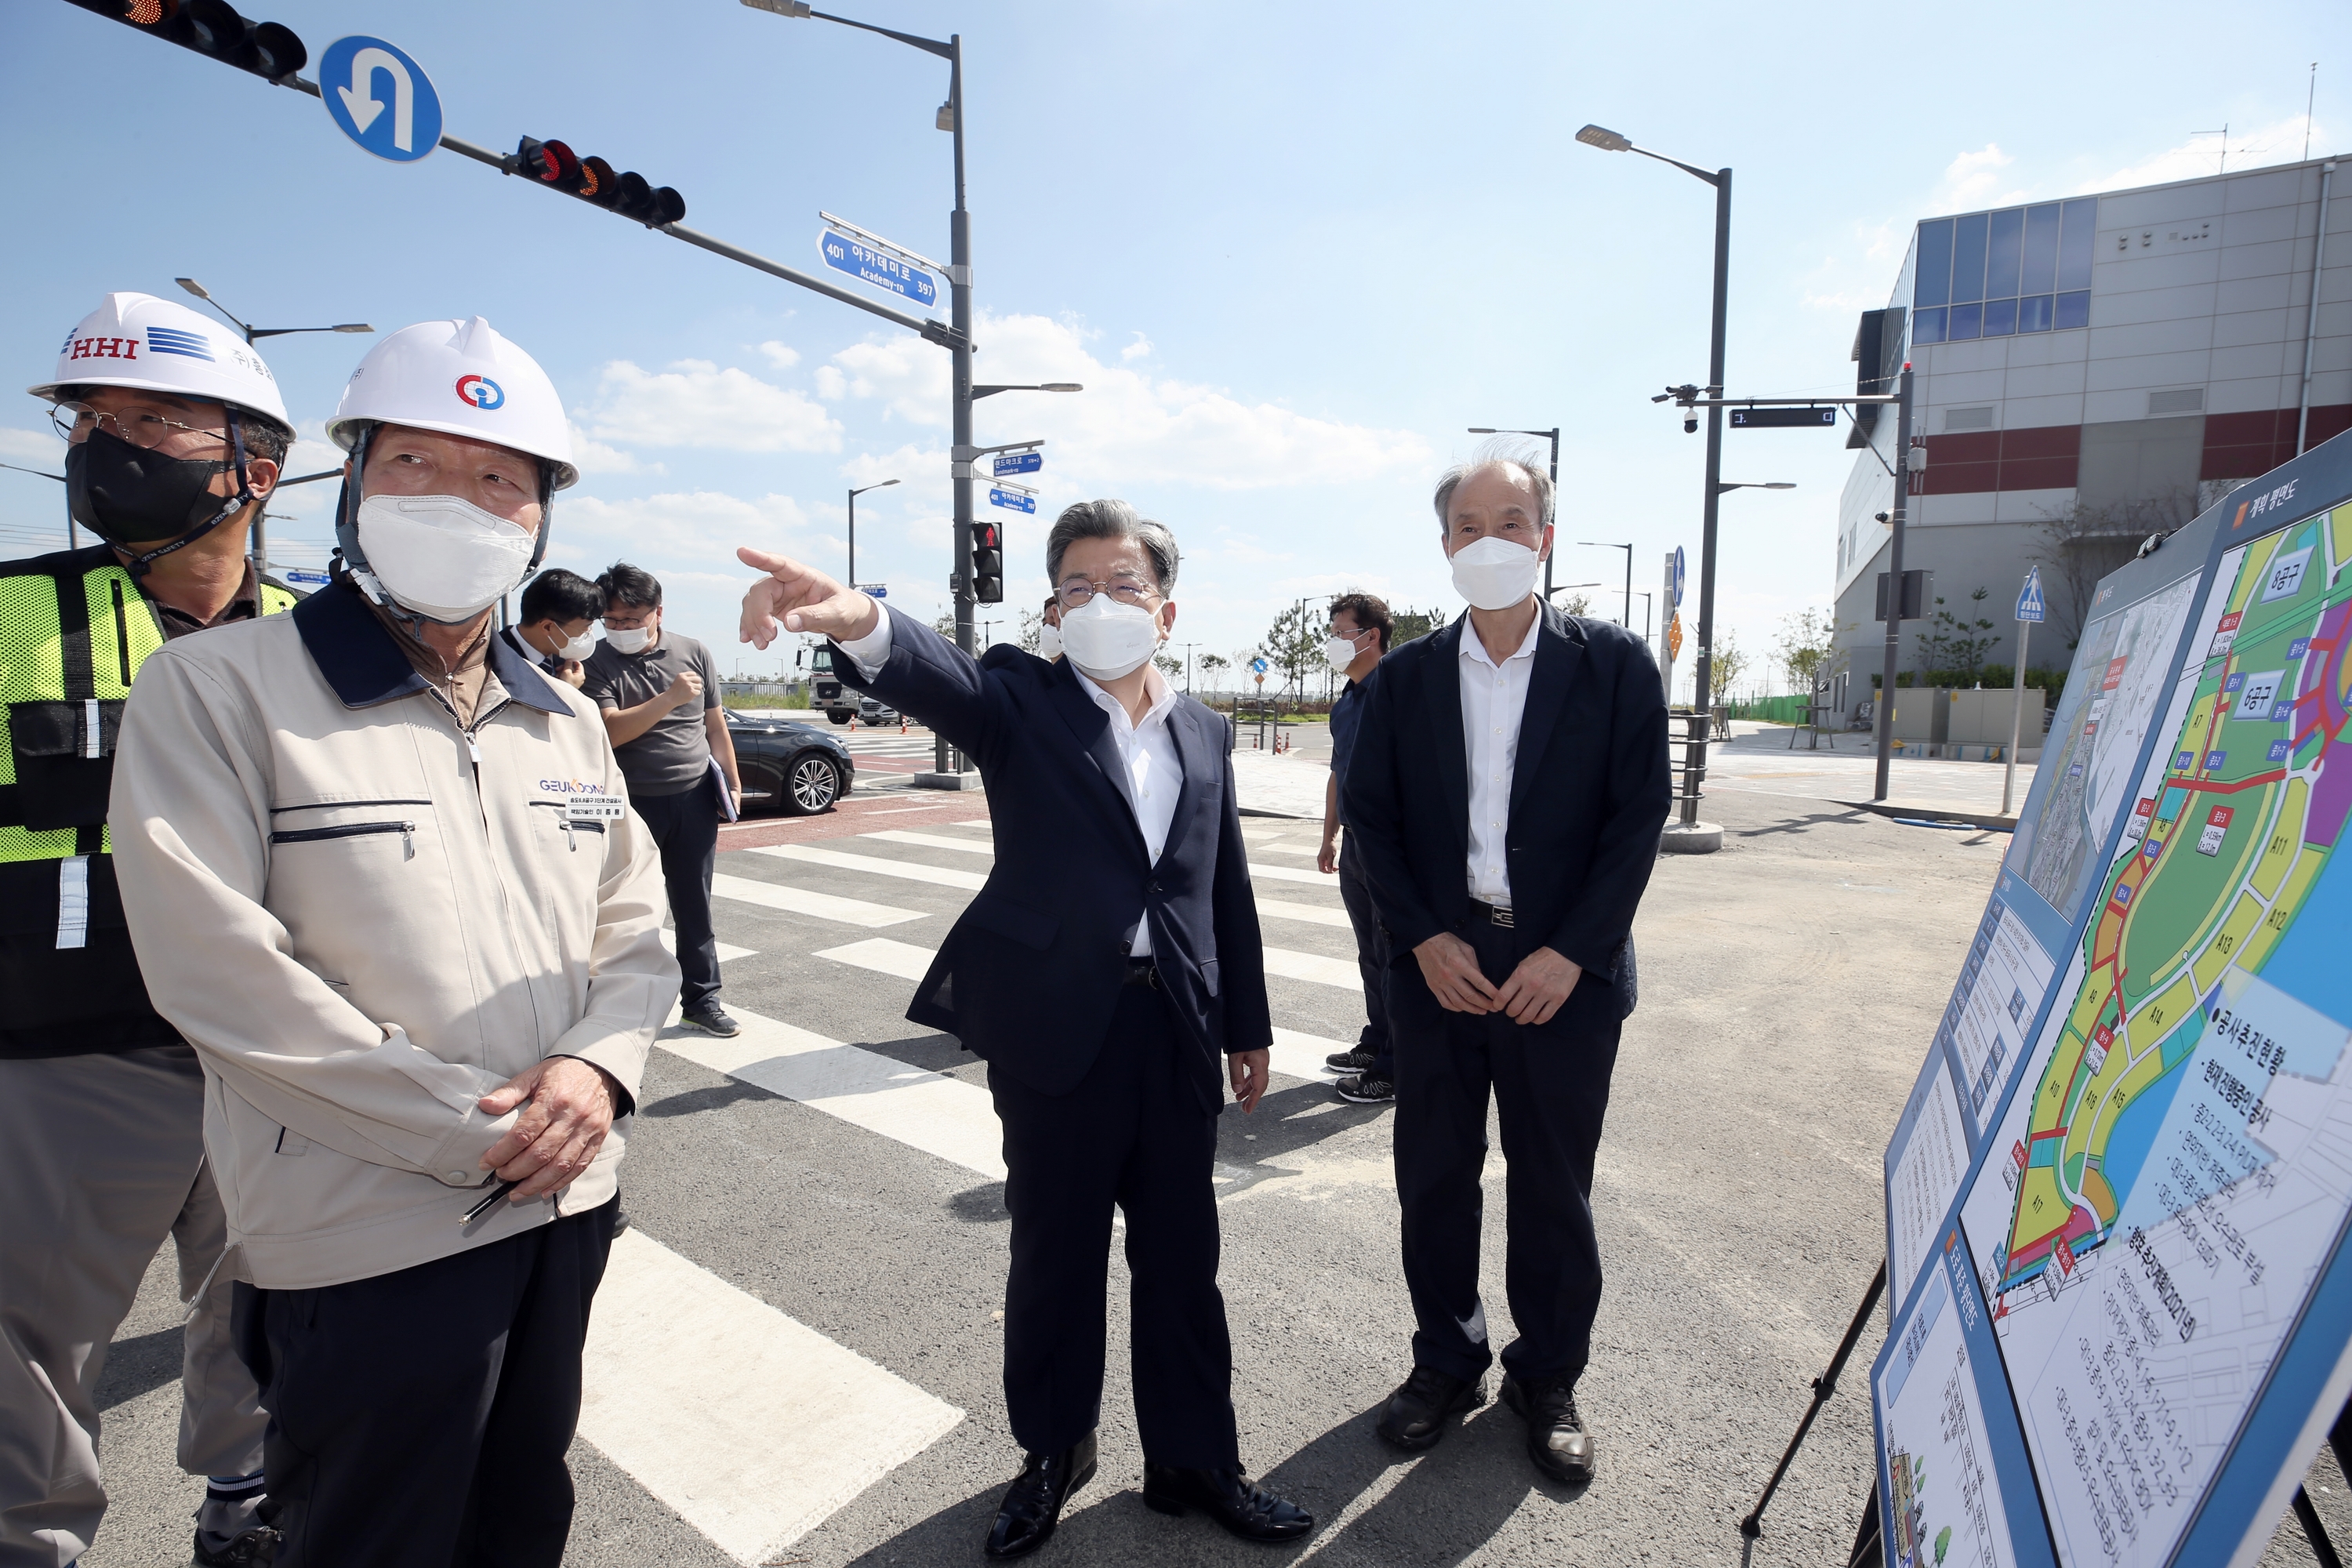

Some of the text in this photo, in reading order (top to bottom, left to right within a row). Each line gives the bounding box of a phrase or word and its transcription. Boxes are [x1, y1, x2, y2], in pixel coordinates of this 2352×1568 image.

[826, 243, 933, 297] 401 아카데미로 397
[860, 267, 904, 293] Academy-ro
[71, 338, 140, 360] HHI
[995, 457, 1022, 468] 랜드마크로
[1002, 492, 1025, 504] 아카데미로
[1004, 502, 1022, 510] Academy-ro
[2250, 478, 2299, 518] 계획 평면도
[158, 540, 185, 554] SAFETY
[2270, 563, 2301, 591] 8공구
[2020, 611, 2041, 619] 횡단보도
[2241, 685, 2273, 710] 6공구
[2192, 714, 2203, 728] A7
[2269, 835, 2289, 857] A11
[2266, 906, 2288, 931] A12
[2215, 931, 2234, 956] A13
[2088, 988, 2097, 1004] A9
[2148, 1004, 2164, 1028] A14
[2217, 1010, 2286, 1077] 공사추진현황
[2049, 1078, 2060, 1099] A10
[2085, 1088, 2097, 1111] A16
[2111, 1087, 2125, 1110] A15
[2202, 1058, 2273, 1134] 현재 진행중인 공사
[2181, 1131, 2211, 1172] 연약지반
[2031, 1192, 2042, 1217] A17
[2157, 1183, 2176, 1214] 대1-3
[1950, 1245, 1961, 1271] 도로
[2241, 1247, 2266, 1287] 부설
[1955, 1264, 1967, 1292] 표준
[2128, 1225, 2197, 1344] 향후 추진계획(2021년)
[2116, 1268, 2140, 1314] 연약지반
[1960, 1283, 1978, 1331] 횡단면도
[2171, 1432, 2193, 1476] 1-12
